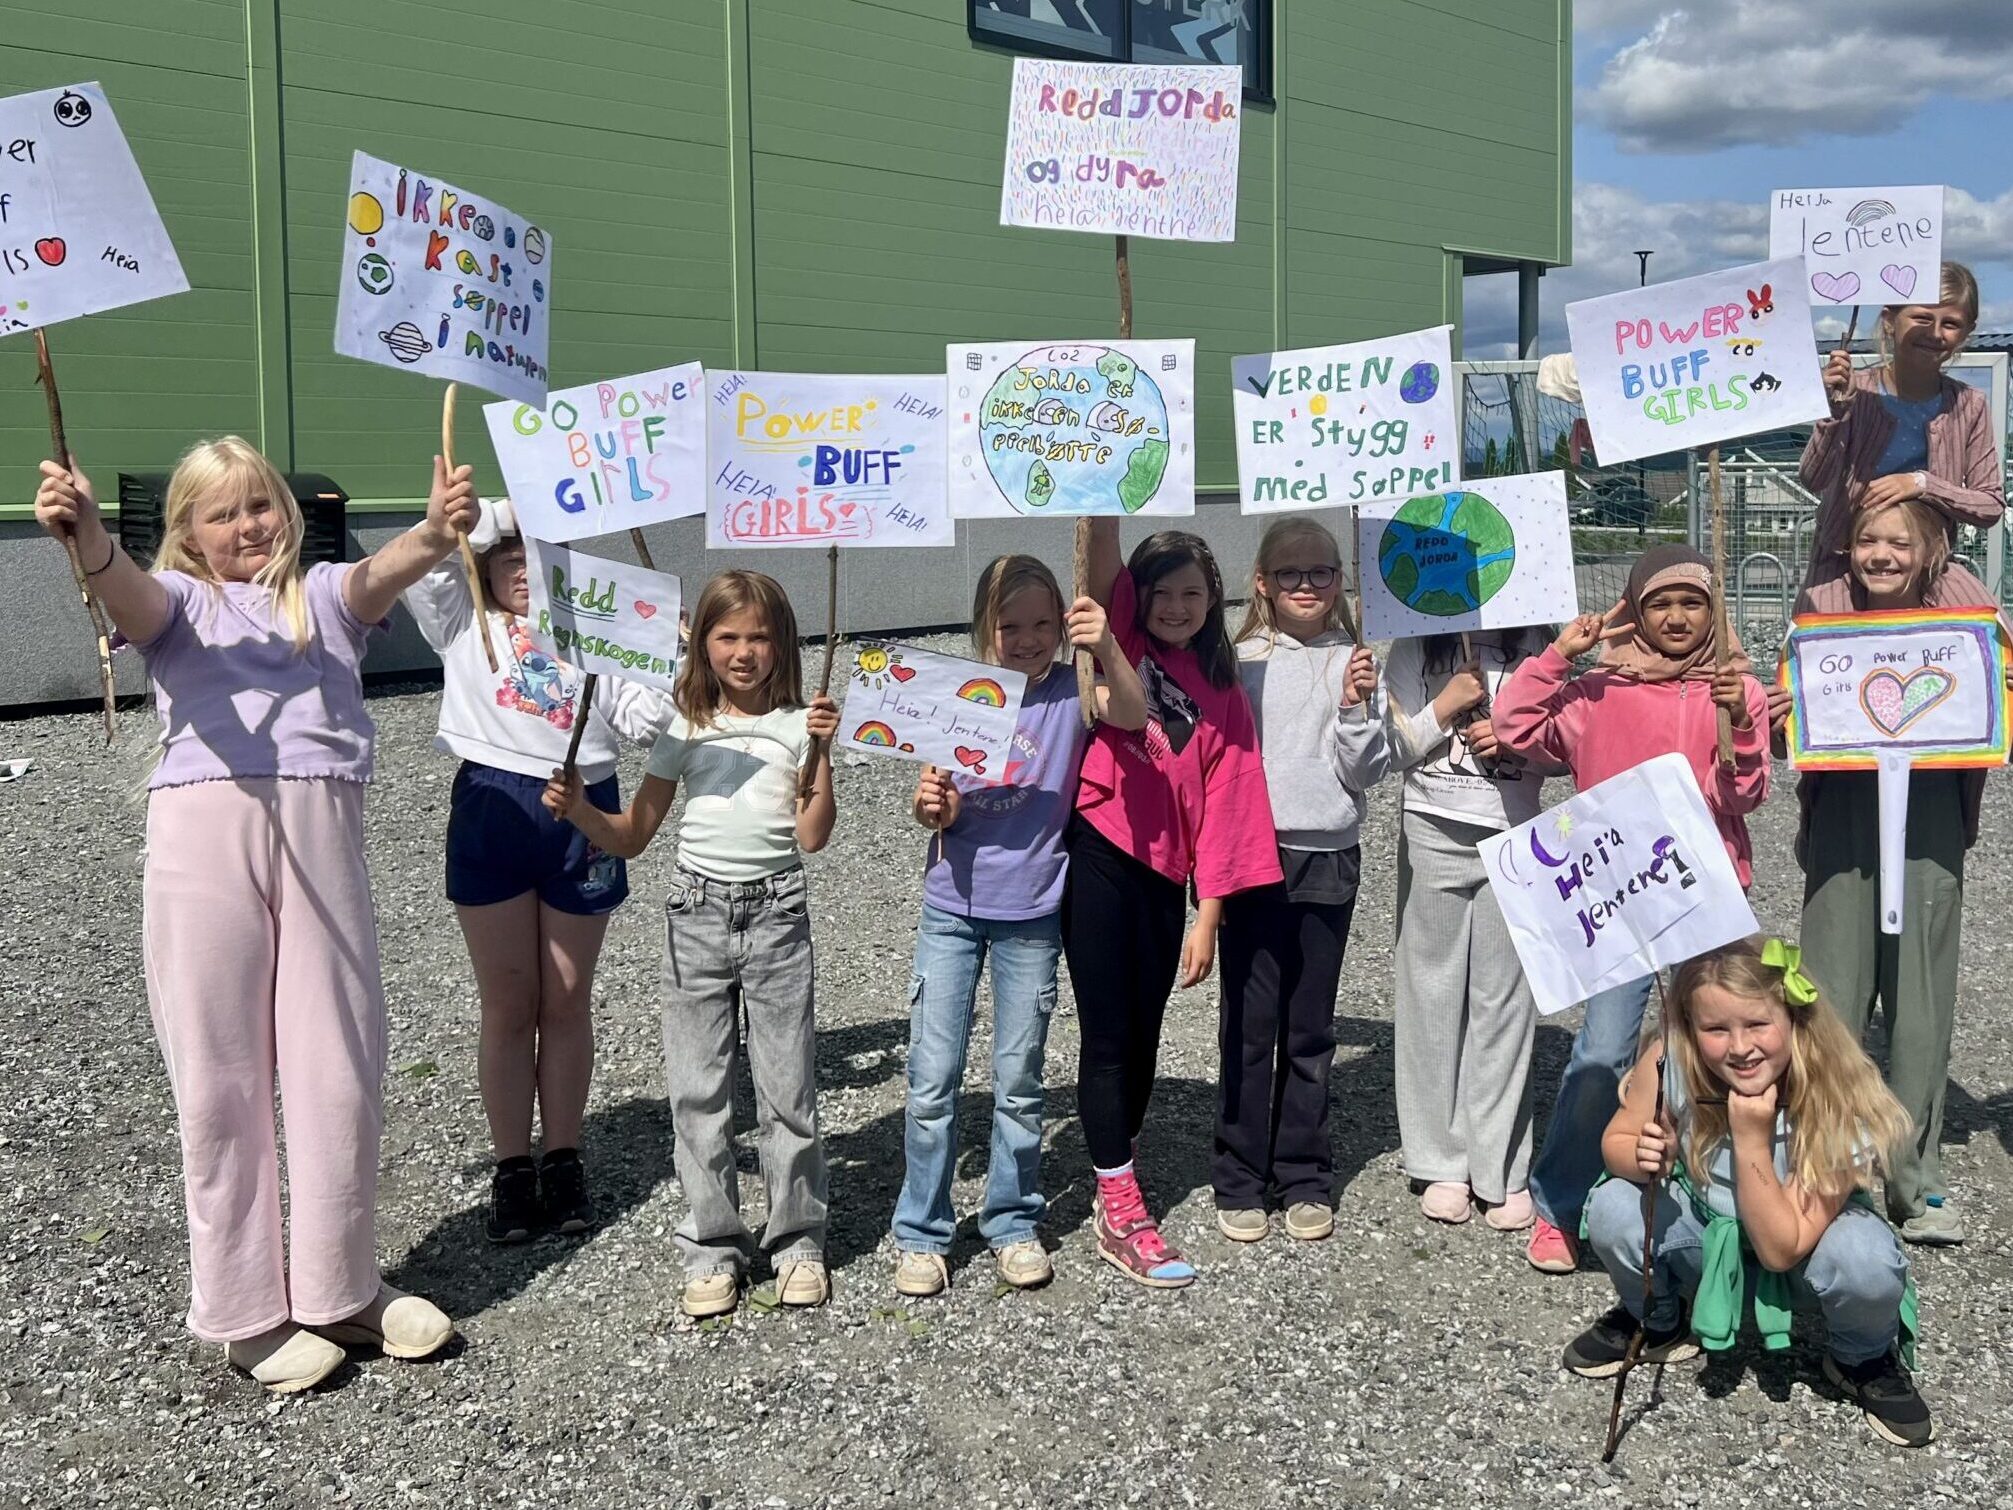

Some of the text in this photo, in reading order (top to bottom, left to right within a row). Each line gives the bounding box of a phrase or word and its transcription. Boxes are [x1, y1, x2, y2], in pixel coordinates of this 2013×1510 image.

[1076, 155, 1165, 190] dyra
[101, 246, 140, 273] Heia
[1615, 303, 1744, 354] POWER
[713, 374, 748, 405] HEIA!
[1621, 349, 1710, 399] BUFF
[893, 392, 943, 420] HEIA!
[1643, 374, 1748, 425] GIRLS
[513, 400, 578, 435] GO
[1252, 420, 1284, 444] ER
[568, 416, 666, 467] BUFF
[716, 461, 777, 500] HEIA!
[814, 445, 901, 486] BUFF
[886, 503, 927, 532] HEIA!
[552, 565, 618, 613] Redd
[1819, 654, 1853, 674] GO
